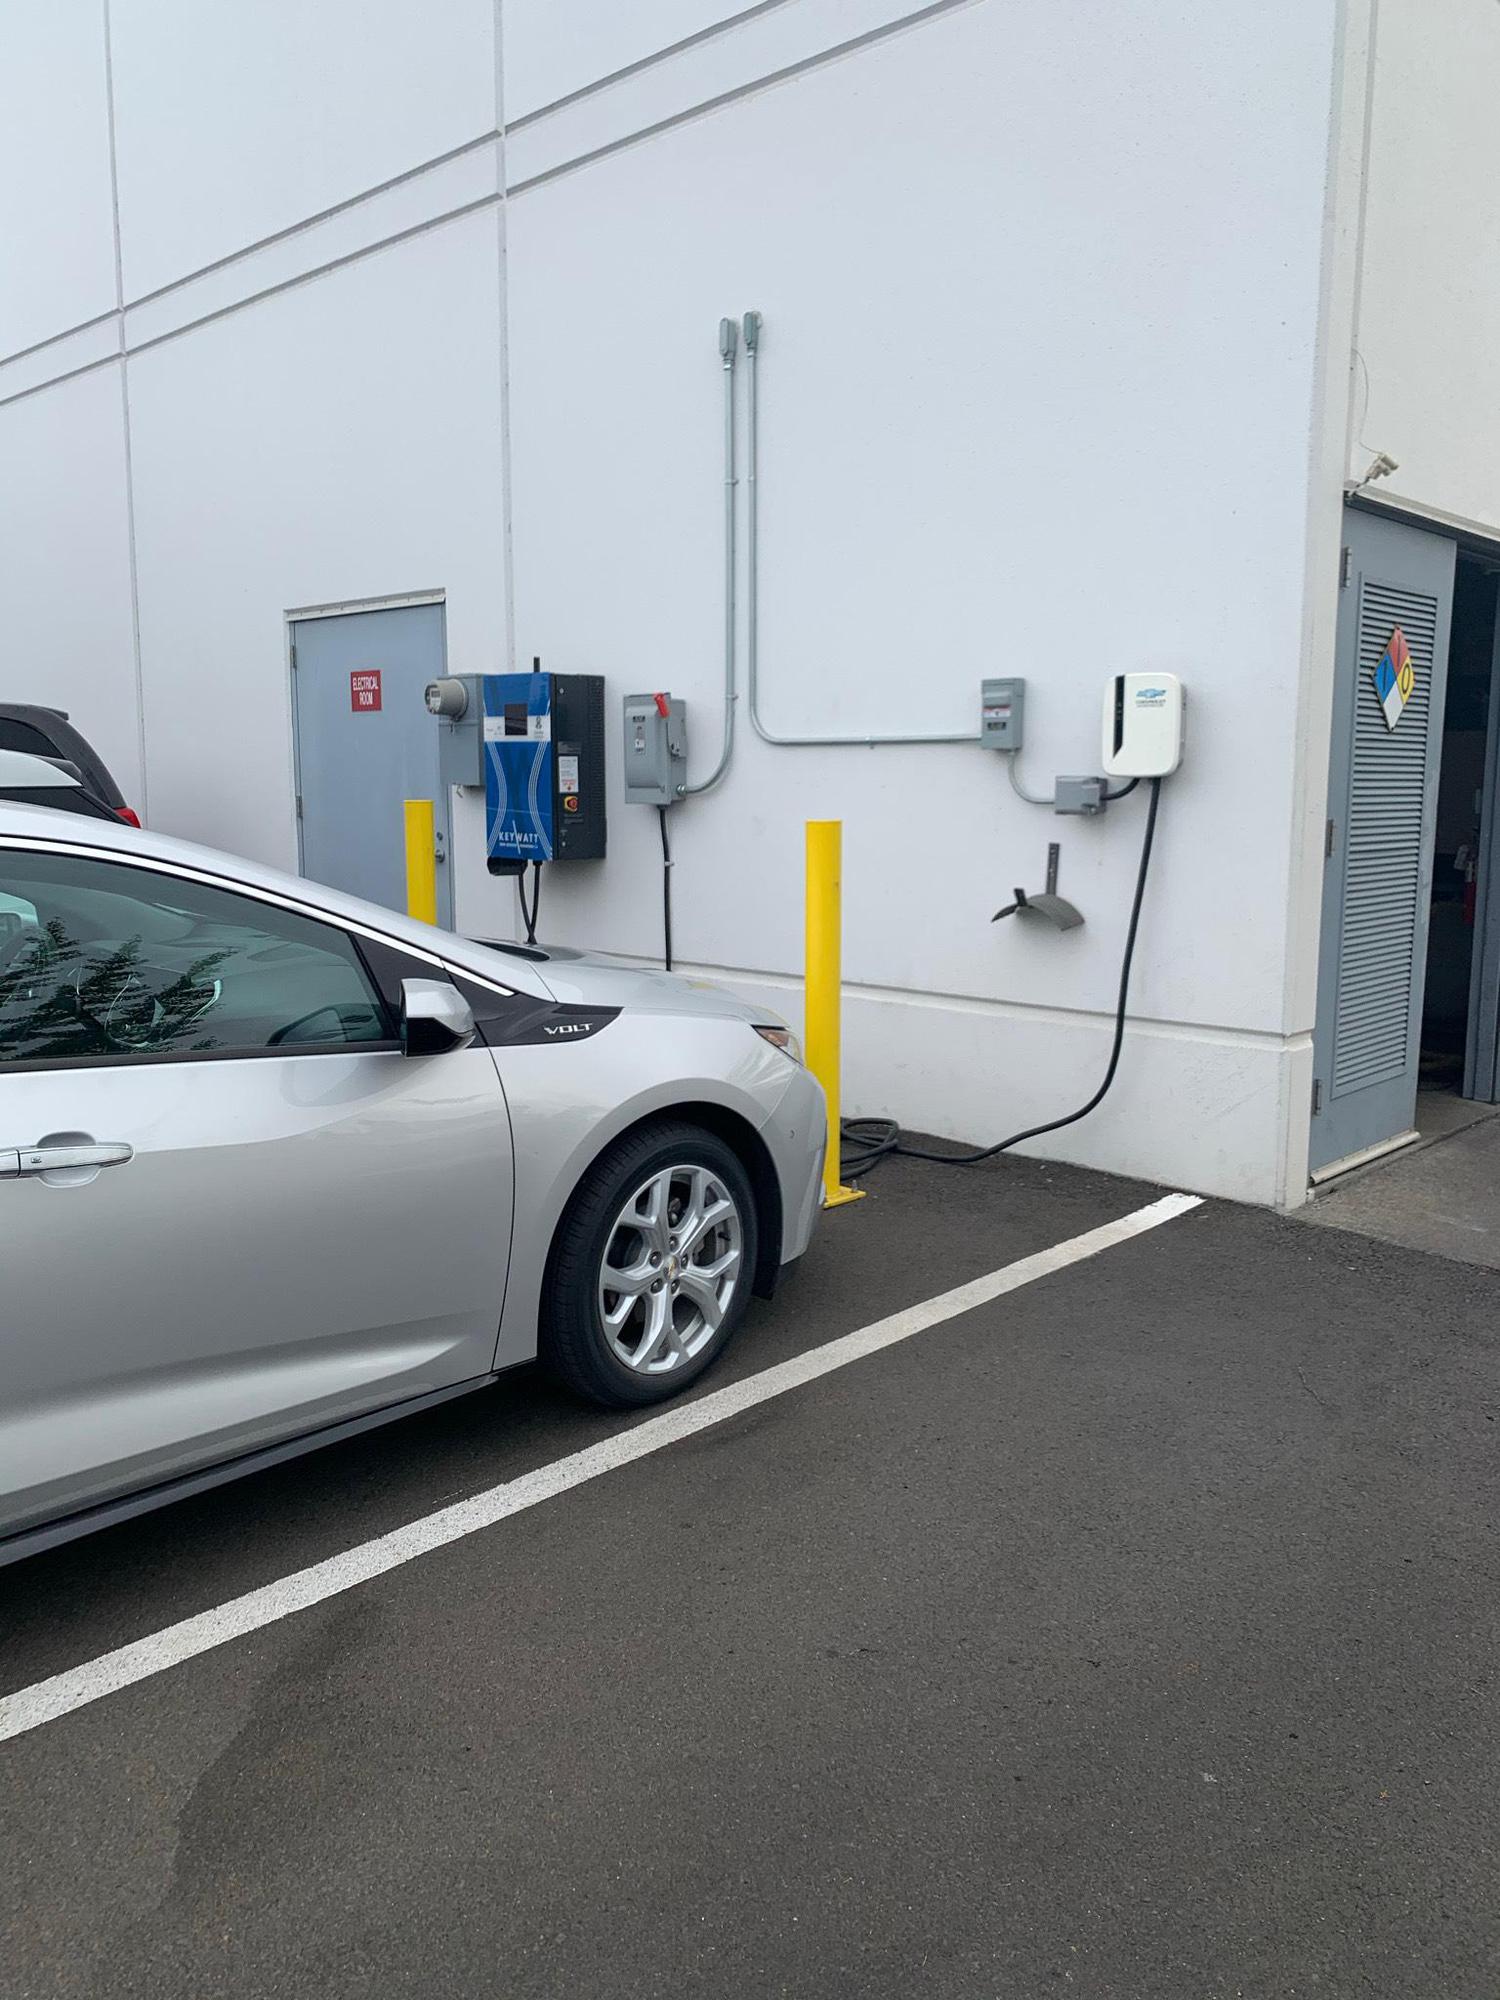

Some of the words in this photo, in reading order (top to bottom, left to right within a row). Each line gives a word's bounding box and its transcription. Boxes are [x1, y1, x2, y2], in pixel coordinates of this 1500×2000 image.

[352, 676, 379, 691] ELECTRICAL
[1401, 663, 1411, 695] 0
[359, 691, 373, 705] ROOM
[499, 832, 538, 843] KEYWATT
[543, 1022, 593, 1035] VOLT
